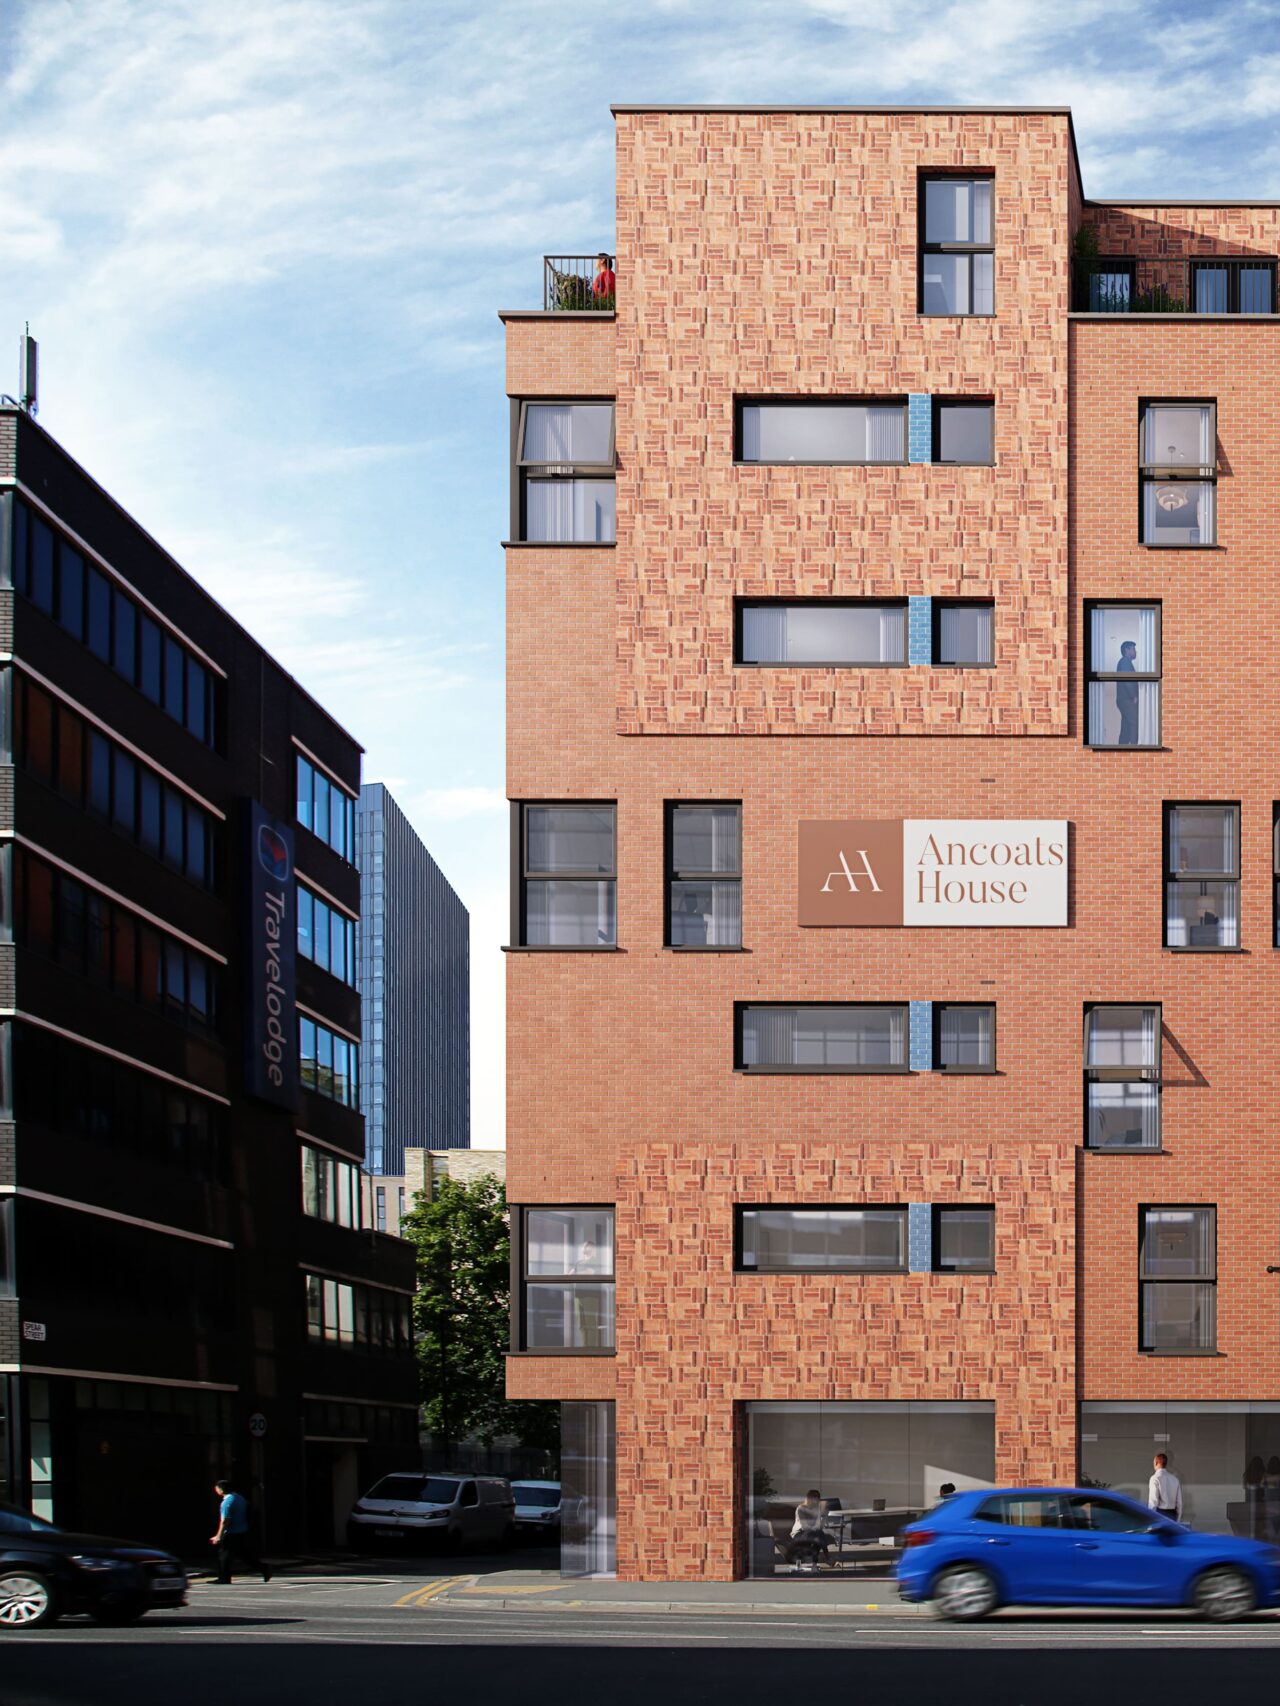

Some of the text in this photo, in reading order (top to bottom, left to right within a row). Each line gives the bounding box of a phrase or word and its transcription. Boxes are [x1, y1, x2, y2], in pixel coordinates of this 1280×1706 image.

[917, 833, 1064, 866] Ancoats
[917, 871, 1029, 904] House
[263, 891, 286, 1087] Travelodge
[24, 1322, 42, 1331] SPEAR
[24, 1331, 44, 1339] STREET
[251, 1418, 265, 1431] 20
